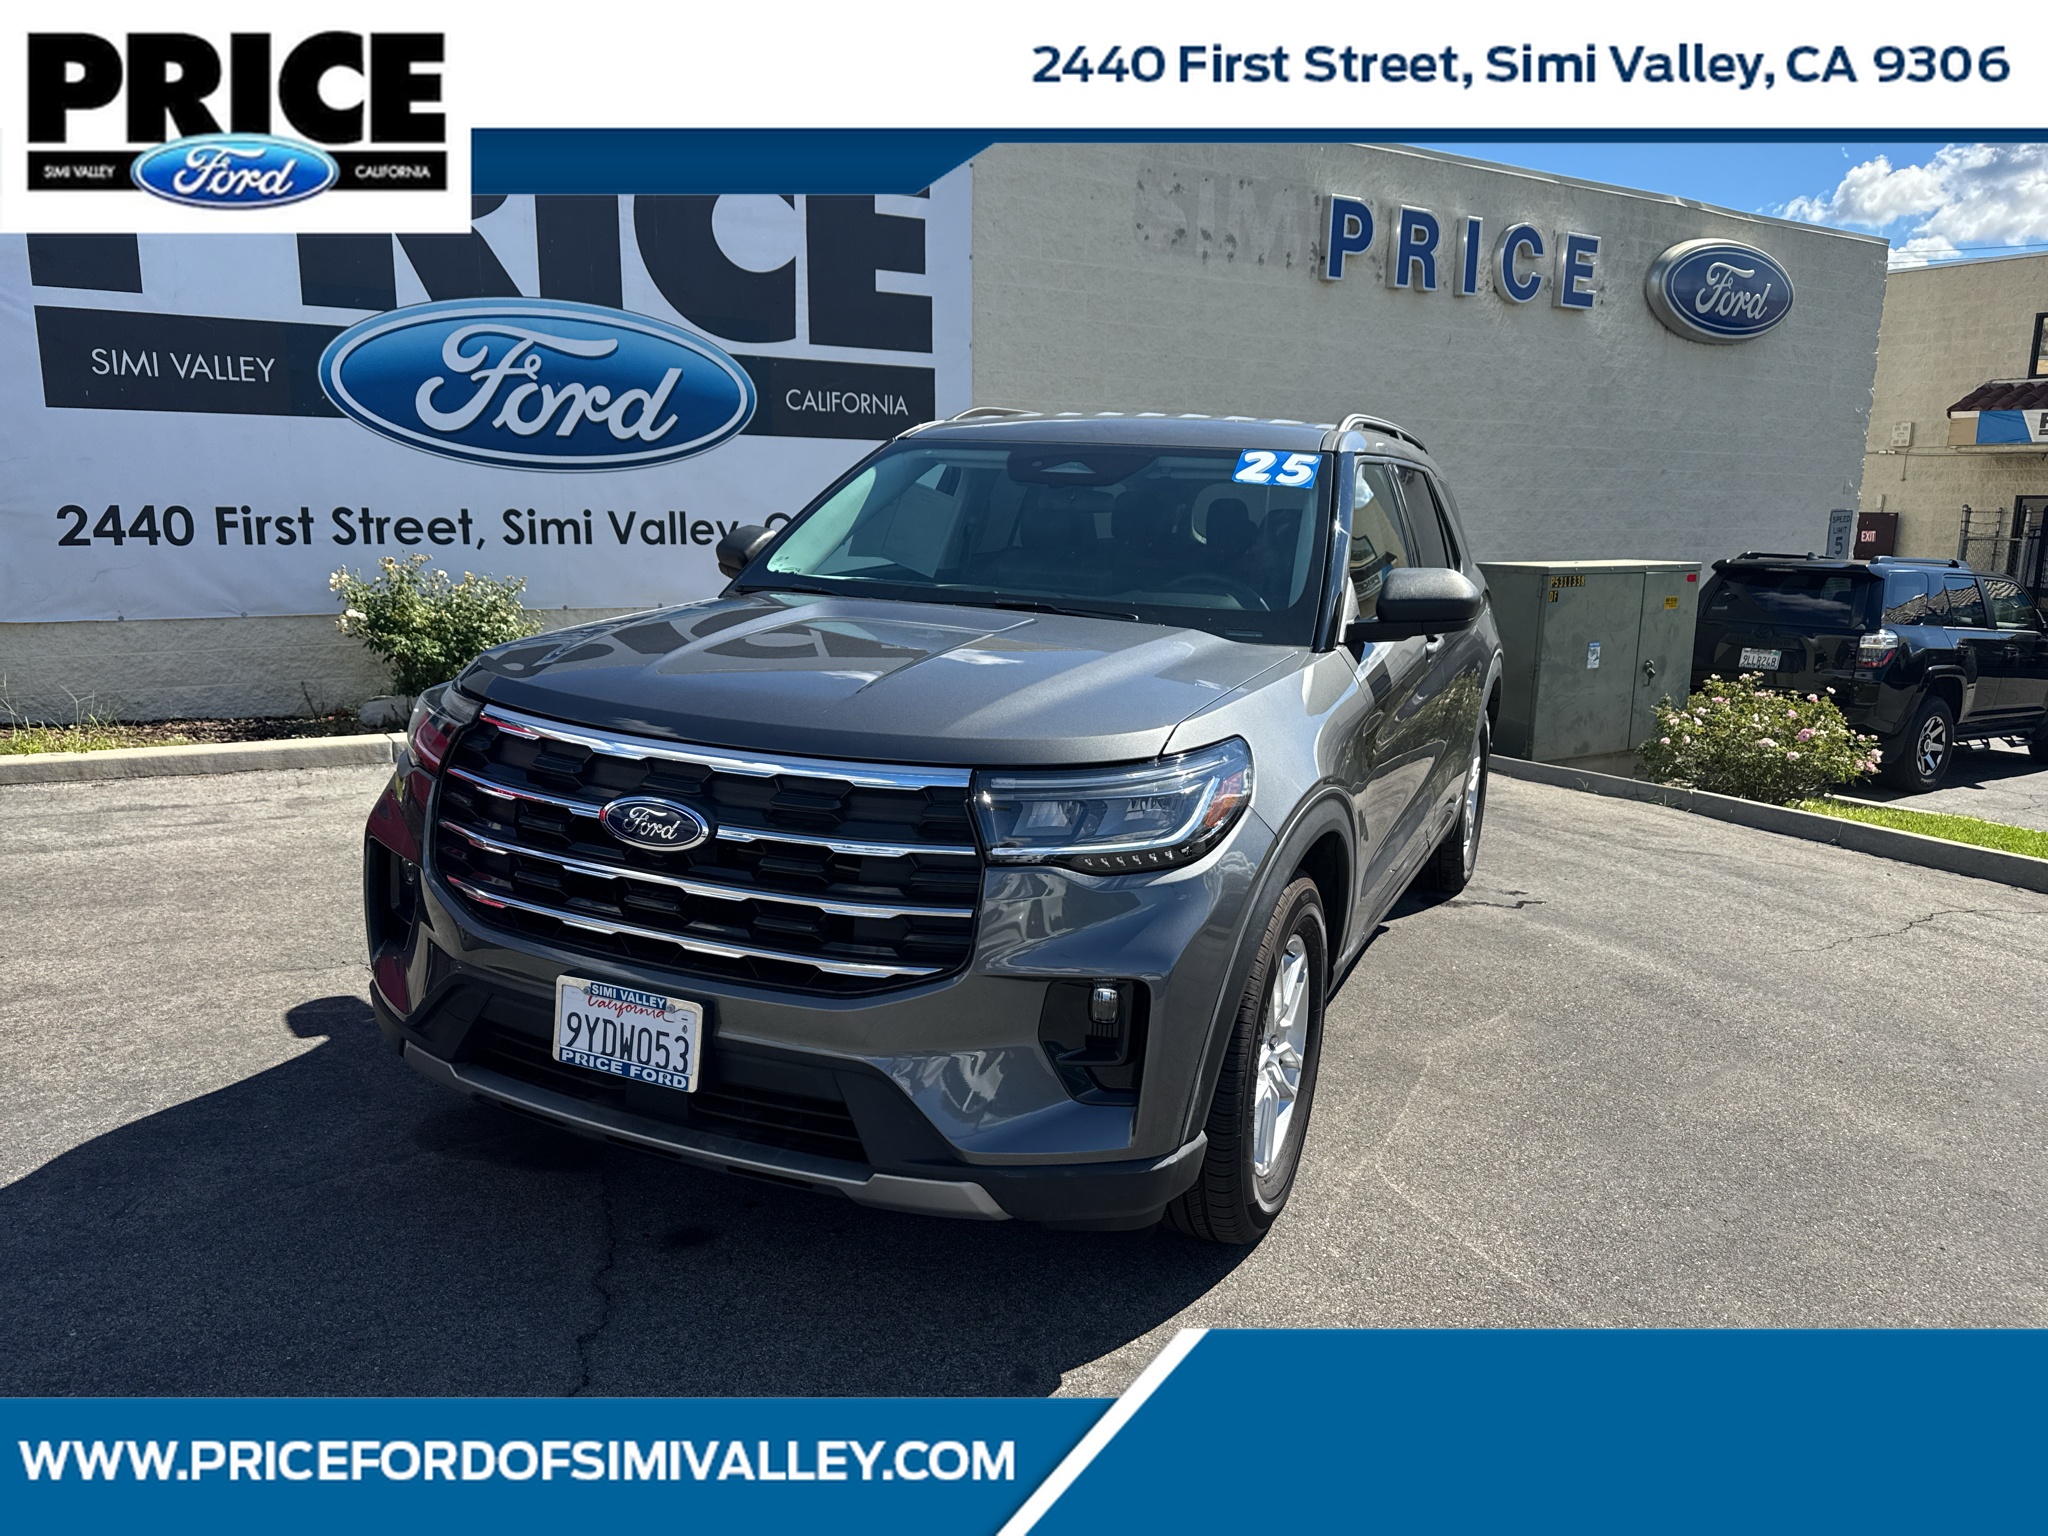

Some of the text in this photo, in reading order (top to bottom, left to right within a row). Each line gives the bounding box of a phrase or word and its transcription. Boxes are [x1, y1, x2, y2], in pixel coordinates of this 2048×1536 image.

[1321, 193, 1601, 310] PRICE
[26, 194, 933, 353] ICE
[1695, 261, 1772, 320] Ford
[91, 348, 276, 383] SIMI VALLEY
[414, 323, 683, 442] Ford
[785, 388, 909, 416] CALIFORNIA
[1235, 451, 1319, 486] 25
[56, 504, 194, 547] 2440
[215, 505, 314, 546] First
[331, 506, 486, 550] Street,
[502, 508, 593, 545] Simi
[1832, 515, 1851, 524] SPEED
[1832, 526, 1848, 535] LIMIT
[1861, 530, 1877, 542] EXIT
[1834, 536, 1843, 555] 5
[622, 806, 681, 840] Ford
[588, 995, 674, 1023] California
[591, 984, 667, 1009] SIMI VALLEY
[566, 1011, 690, 1074] 9YDW053
[561, 1049, 687, 1089] PRICE FORD
